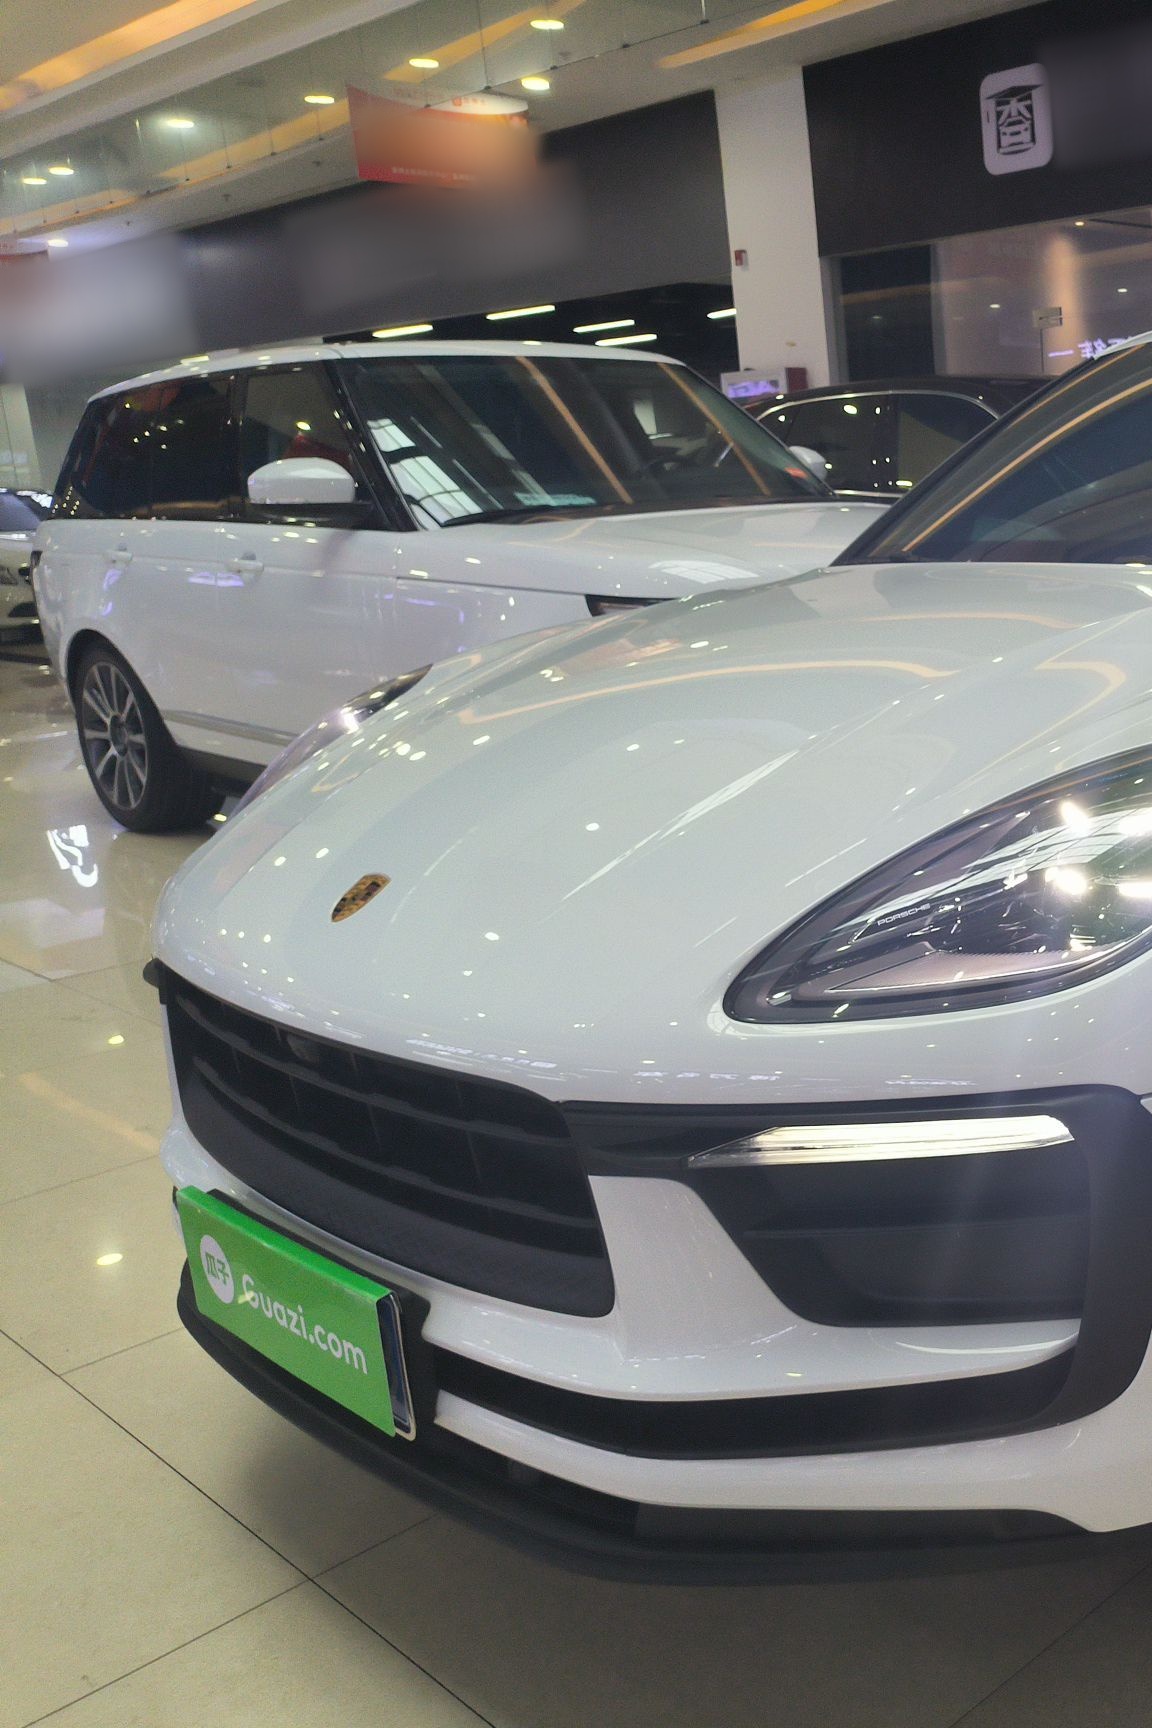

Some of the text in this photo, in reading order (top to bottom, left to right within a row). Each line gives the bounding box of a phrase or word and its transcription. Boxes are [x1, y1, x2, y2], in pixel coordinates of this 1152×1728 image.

[878, 903, 930, 925] PORSCHE
[205, 1253, 368, 1375] 瓜子 Guazi.com
